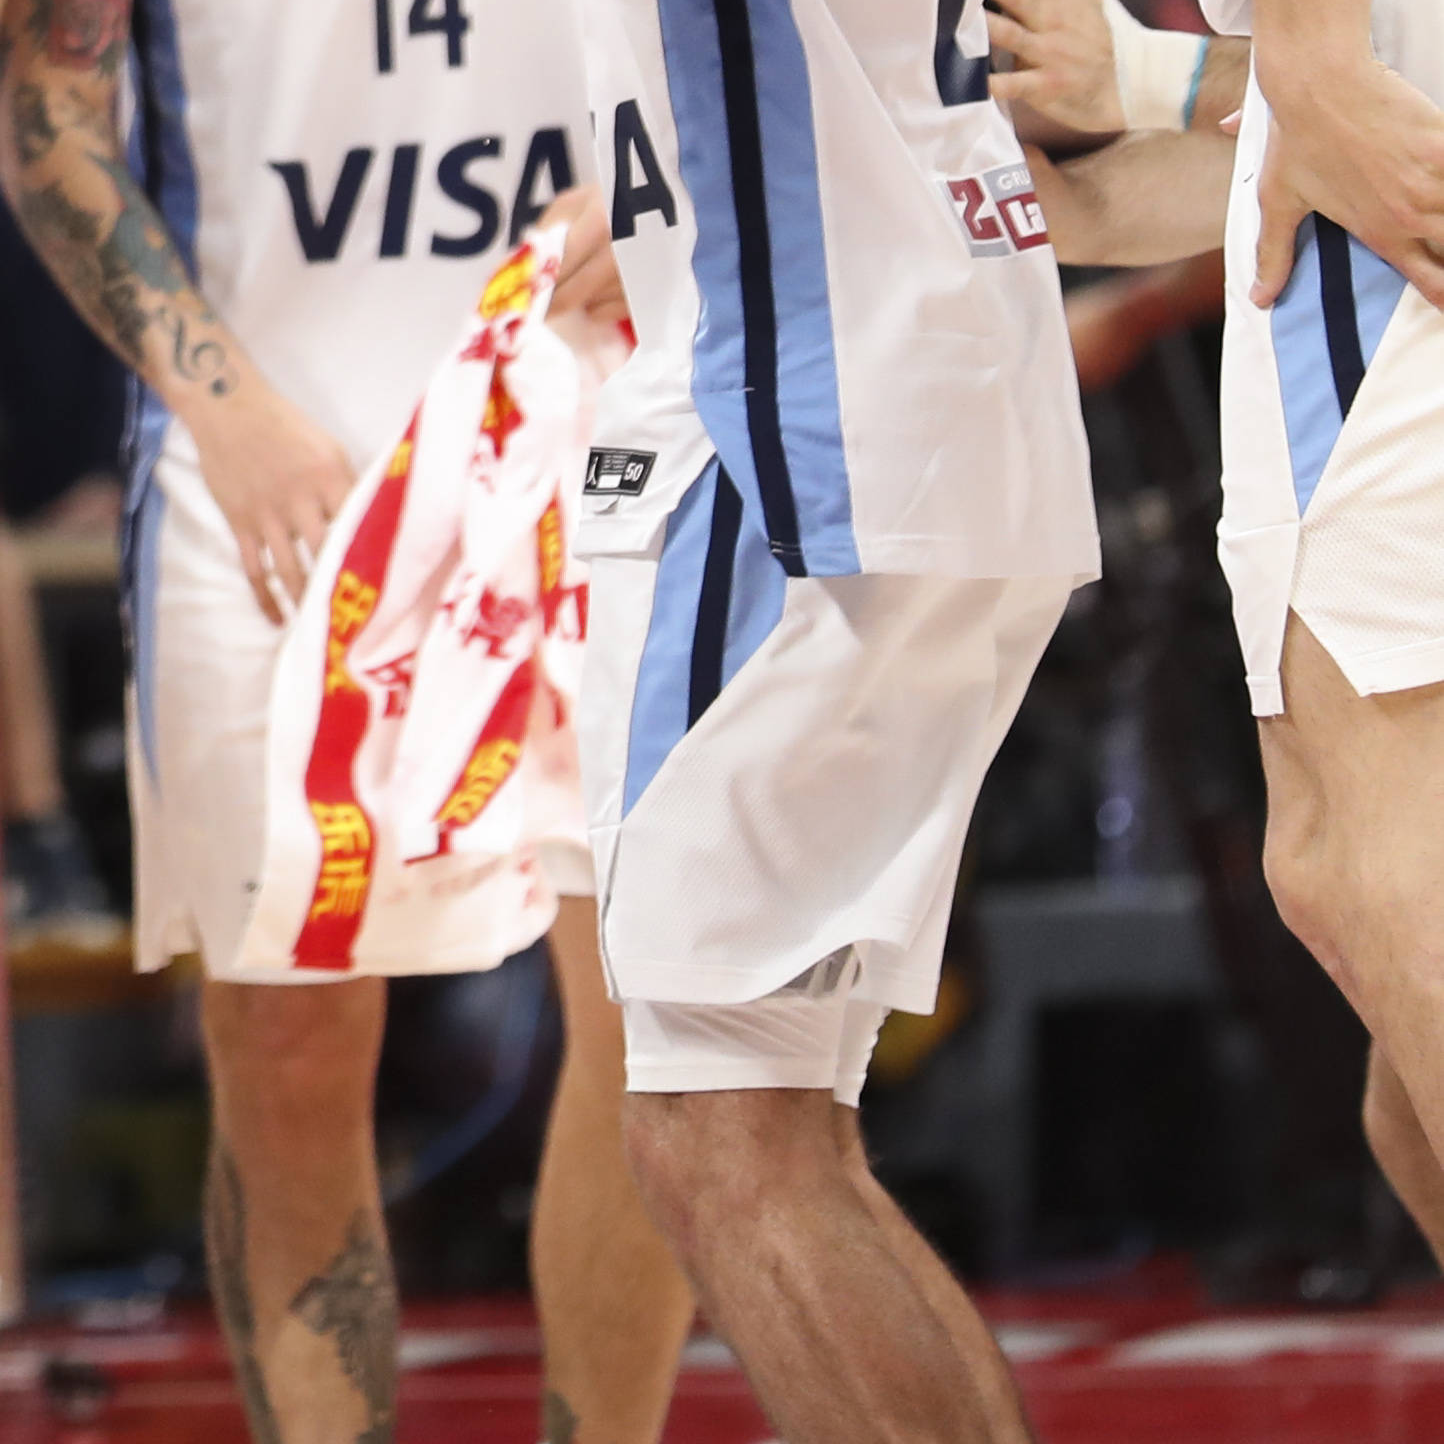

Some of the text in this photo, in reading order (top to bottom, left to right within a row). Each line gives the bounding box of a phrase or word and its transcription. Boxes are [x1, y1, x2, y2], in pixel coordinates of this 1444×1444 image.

[998, 169, 1032, 191] GRU
[268, 127, 578, 264] VISA
[623, 462, 644, 482] 50
